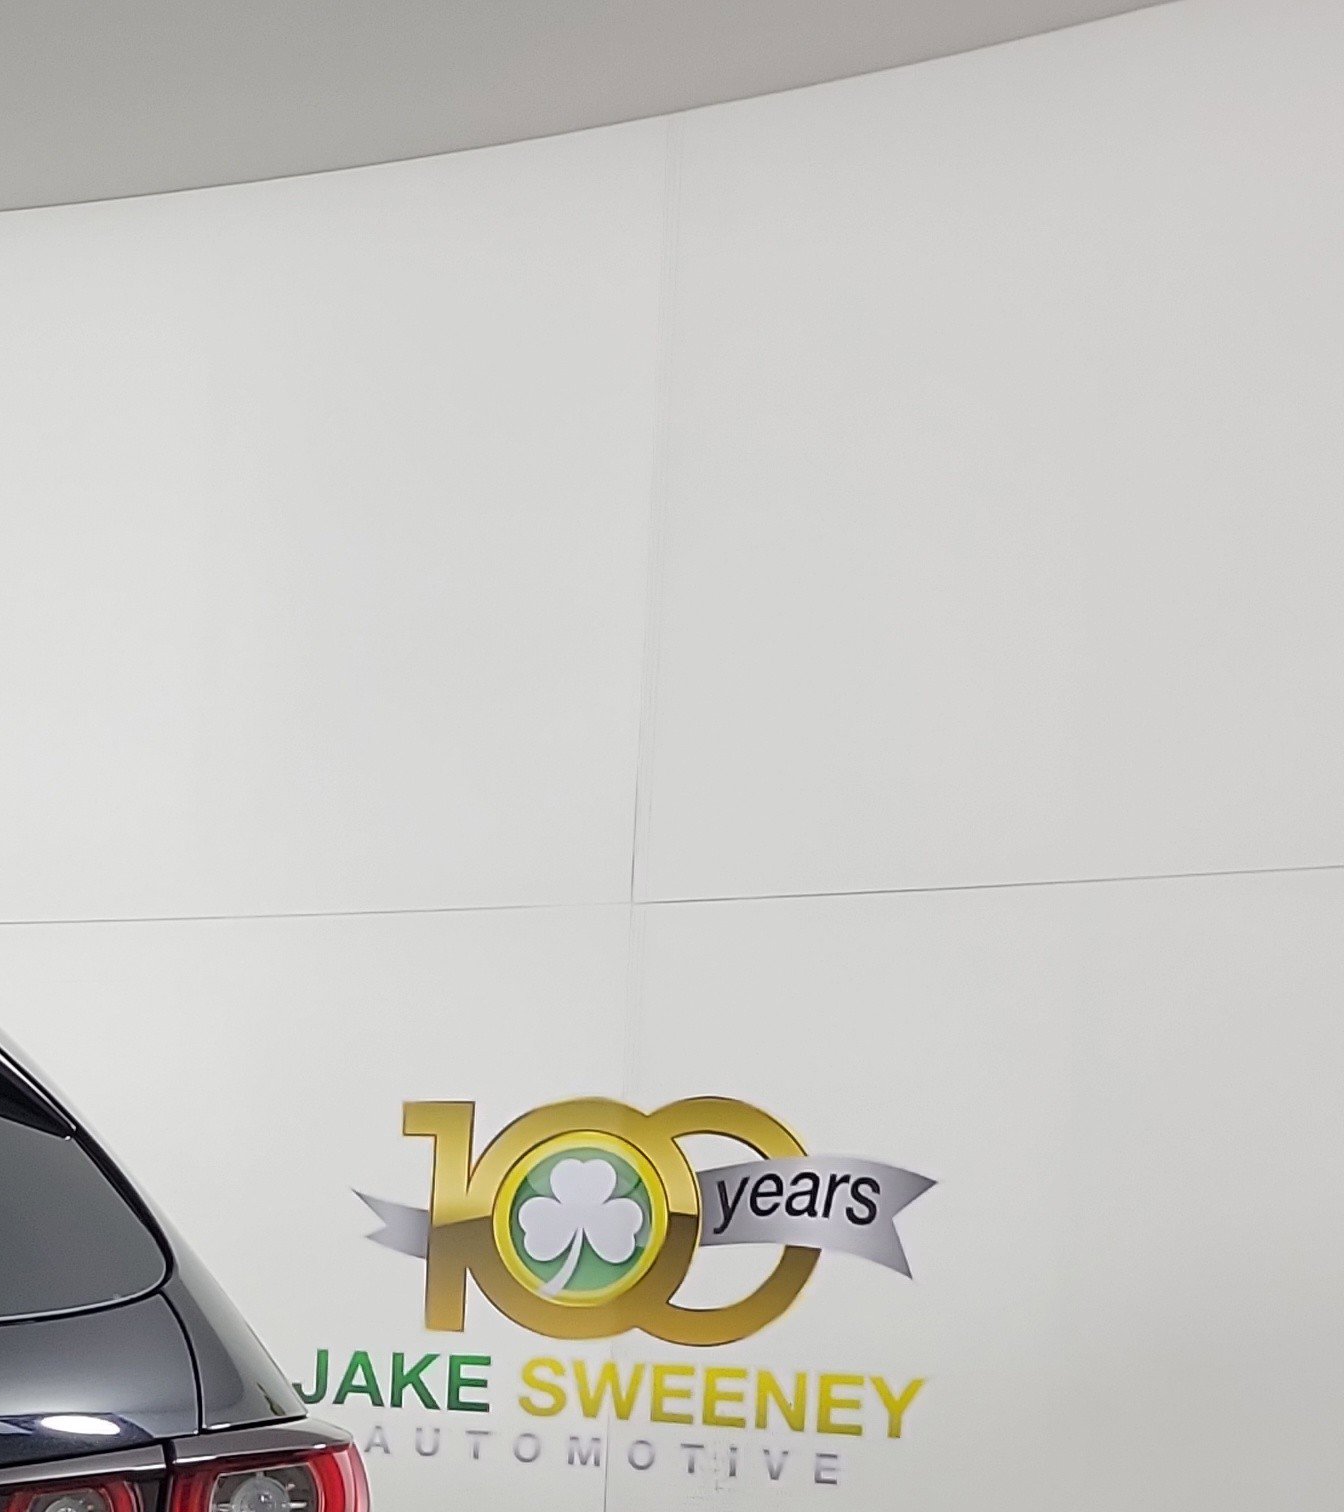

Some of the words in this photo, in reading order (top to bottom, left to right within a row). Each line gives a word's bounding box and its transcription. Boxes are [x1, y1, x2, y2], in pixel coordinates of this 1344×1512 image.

[401, 1094, 823, 1347] 100
[713, 1171, 881, 1236] years
[291, 1348, 492, 1413] JAKE
[517, 1357, 927, 1439] SWEENEY
[363, 1425, 840, 1485] AUTOMOTIVE
